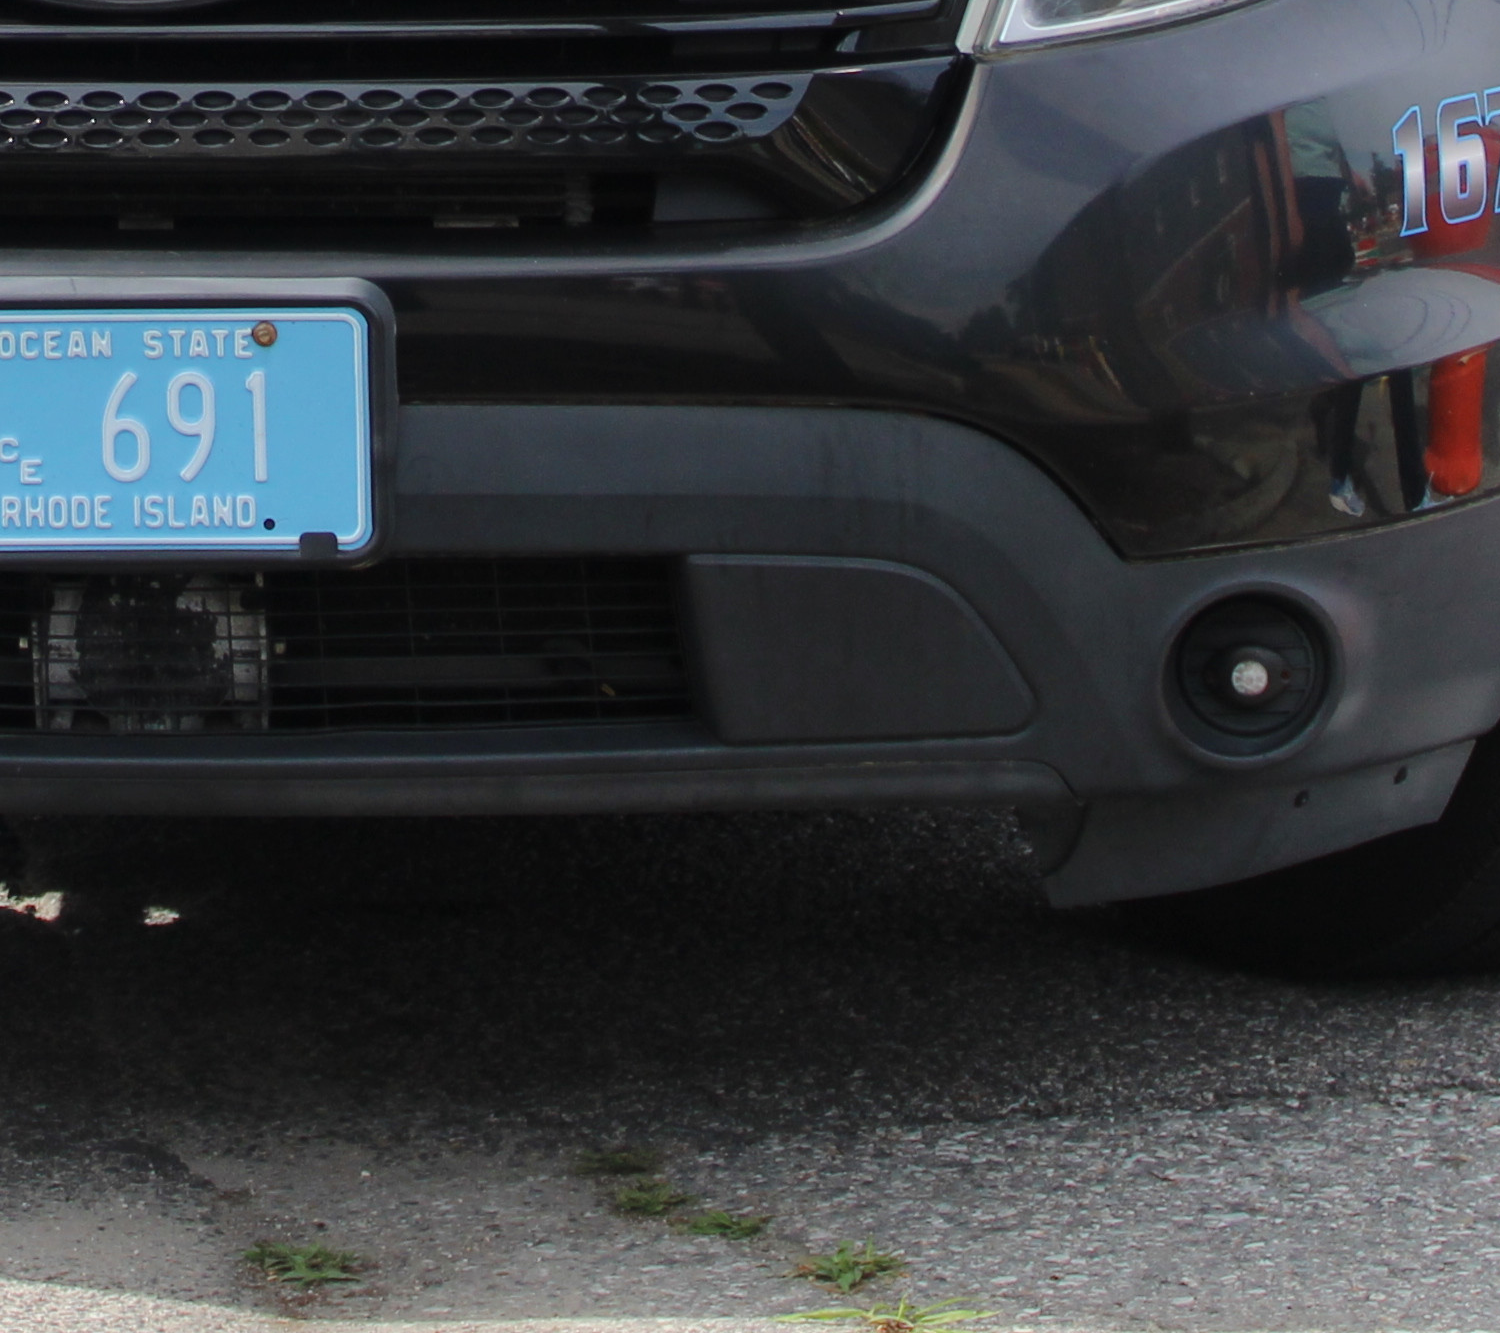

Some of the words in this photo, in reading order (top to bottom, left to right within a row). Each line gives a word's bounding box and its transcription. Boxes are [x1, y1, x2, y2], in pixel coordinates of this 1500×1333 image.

[143, 328, 255, 359] STATE
[101, 370, 268, 483] 691
[1, 494, 113, 529] RHODE
[133, 493, 257, 528] ISLAND
